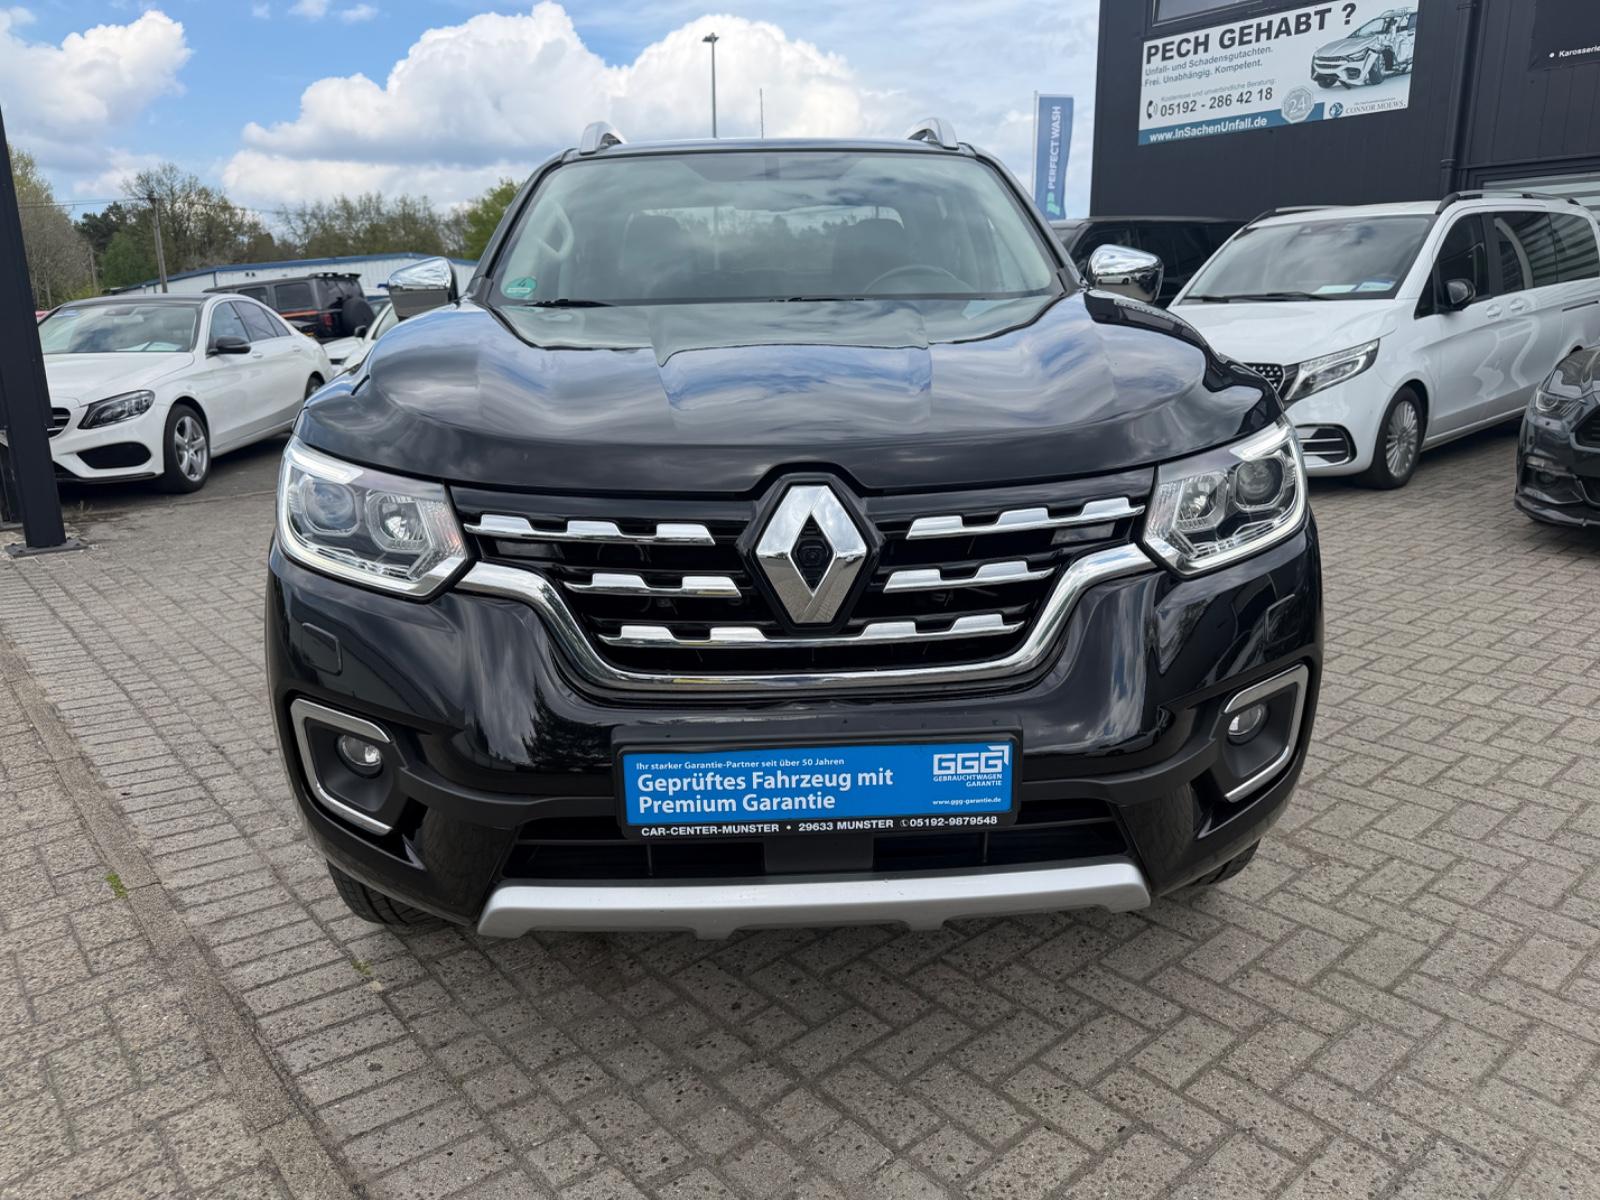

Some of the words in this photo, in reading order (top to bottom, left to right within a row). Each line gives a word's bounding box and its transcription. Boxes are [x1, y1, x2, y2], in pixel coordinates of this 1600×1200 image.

[1146, 35, 1209, 64] PECH
[1219, 8, 1332, 49] GEHABT
[1341, 3, 1356, 25] ?
[1144, 77, 1160, 87] Frei.
[1163, 66, 1212, 85] Unabhängig.
[1214, 59, 1263, 77] Kompetent.
[1145, 64, 1170, 76] Unfall-
[1171, 60, 1186, 72] und
[1189, 47, 1273, 69] Schadensgutachten.
[1161, 96, 1196, 117] 05192
[1209, 91, 1232, 109] 286
[1236, 89, 1252, 105] 42
[1258, 87, 1273, 102] 18
[1051, 106, 1061, 139] WASH
[1149, 117, 1267, 142] www.InSachenUnfall.de
[1048, 141, 1059, 189] PERFECT
[780, 759, 799, 767] über
[815, 758, 844, 766] Jahren
[933, 752, 1002, 775] GGG
[637, 772, 746, 793] Geprüftes
[752, 770, 852, 790] Fahrzeug
[858, 769, 893, 785] mit
[933, 774, 1002, 782] GEBRAUCHTWAGEN
[639, 795, 736, 814] Premium
[742, 790, 835, 810] Garantie
[933, 797, 1001, 806] www.ggg-garantie.de
[641, 825, 779, 836] CAR-CENTER-MUNSTER
[799, 821, 834, 831] 29633
[837, 819, 893, 829] MUNSTER
[910, 816, 997, 827] 05192-9879548
